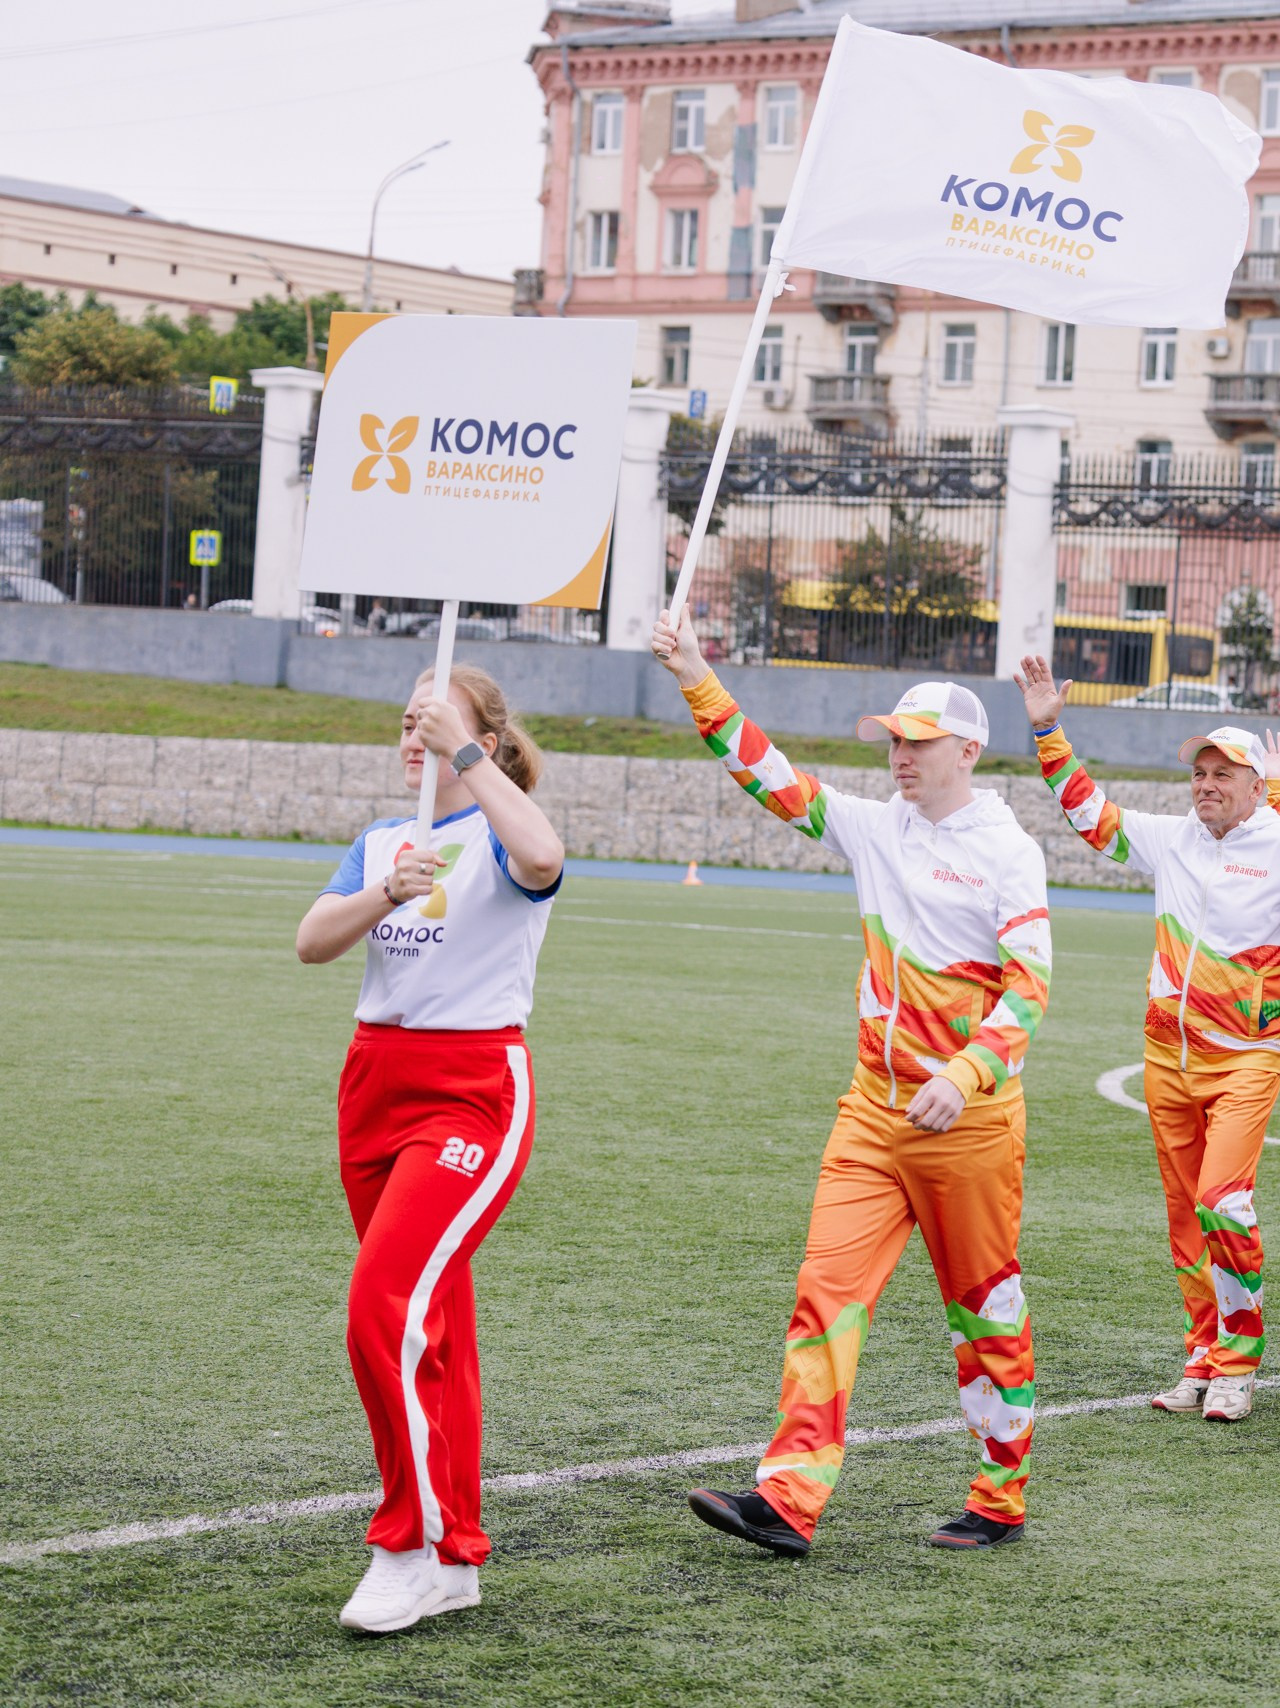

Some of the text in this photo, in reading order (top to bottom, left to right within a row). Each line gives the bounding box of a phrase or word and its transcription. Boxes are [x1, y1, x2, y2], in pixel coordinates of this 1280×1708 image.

[940, 174, 1124, 243] КОМОС
[950, 212, 1095, 261] ВАРАКСИНО
[945, 236, 1087, 279] ПТИЦЕФАБРИКА
[430, 417, 578, 461] КОМОС
[426, 460, 545, 485] ВАРАКСИНО
[423, 485, 541, 503] ПТИЦЕФАБРИКА
[371, 924, 445, 943] КОМОС
[385, 946, 419, 957] ГРУПП
[440, 1136, 485, 1172] 20
